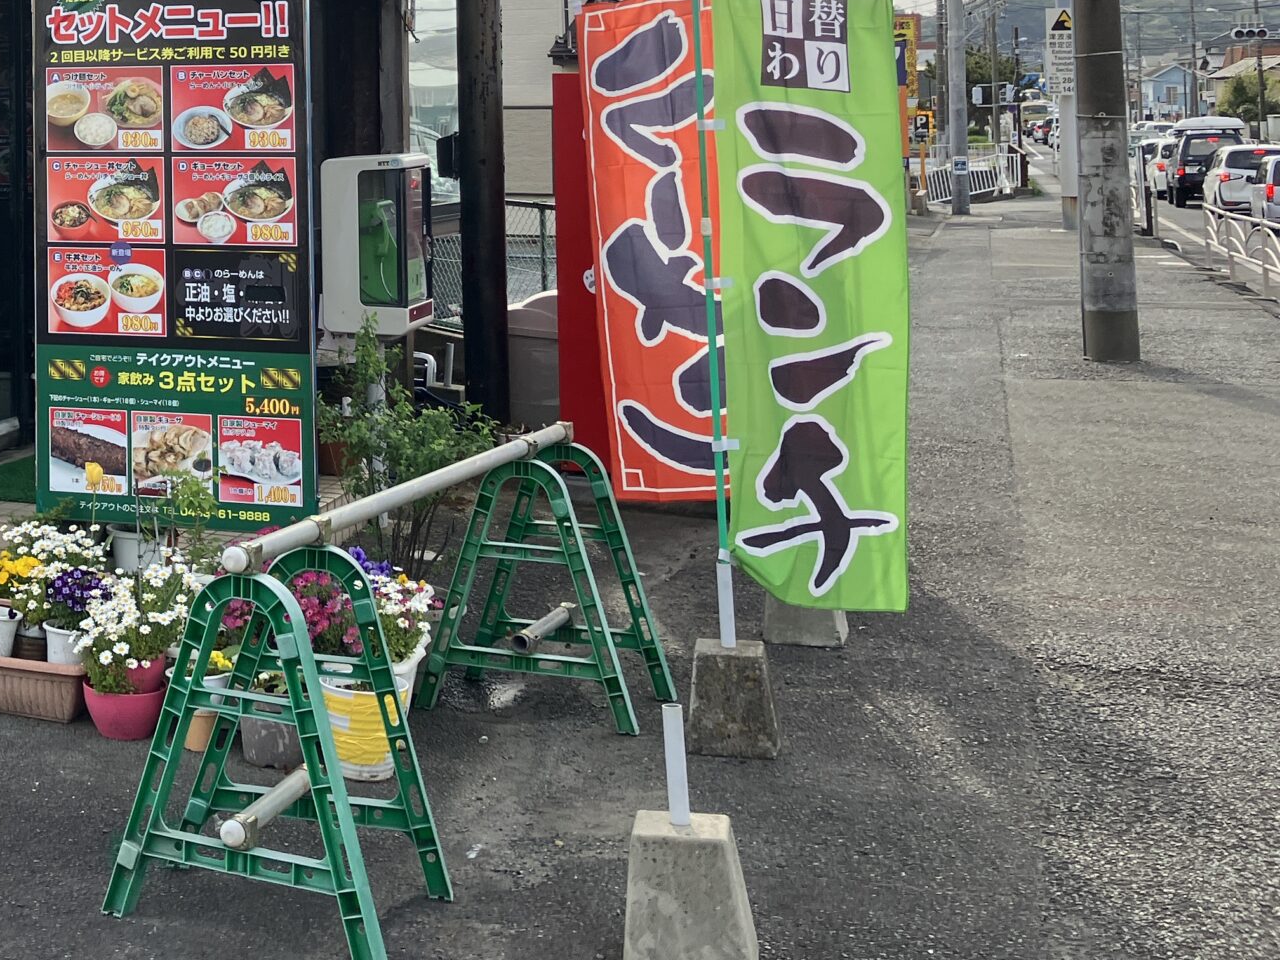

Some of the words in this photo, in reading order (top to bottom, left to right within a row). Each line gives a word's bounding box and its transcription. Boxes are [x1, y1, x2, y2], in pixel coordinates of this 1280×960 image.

[190, 70, 250, 80] チャーハンセット
[122, 131, 159, 148] 930円
[249, 131, 288, 148] 930円
[191, 161, 244, 171] ギョーザセット
[377, 160, 390, 168] NTT
[122, 221, 159, 238] 950円
[250, 224, 290, 241] 980円
[65, 252, 102, 262] 牛丼セット
[122, 314, 159, 332] 980円
[135, 352, 255, 370] テイクアウトメニュー
[117, 370, 155, 387] 家飲み
[158, 370, 256, 394] 3点セット
[245, 396, 300, 416] 5,400円
[257, 485, 297, 504] 1,400円
